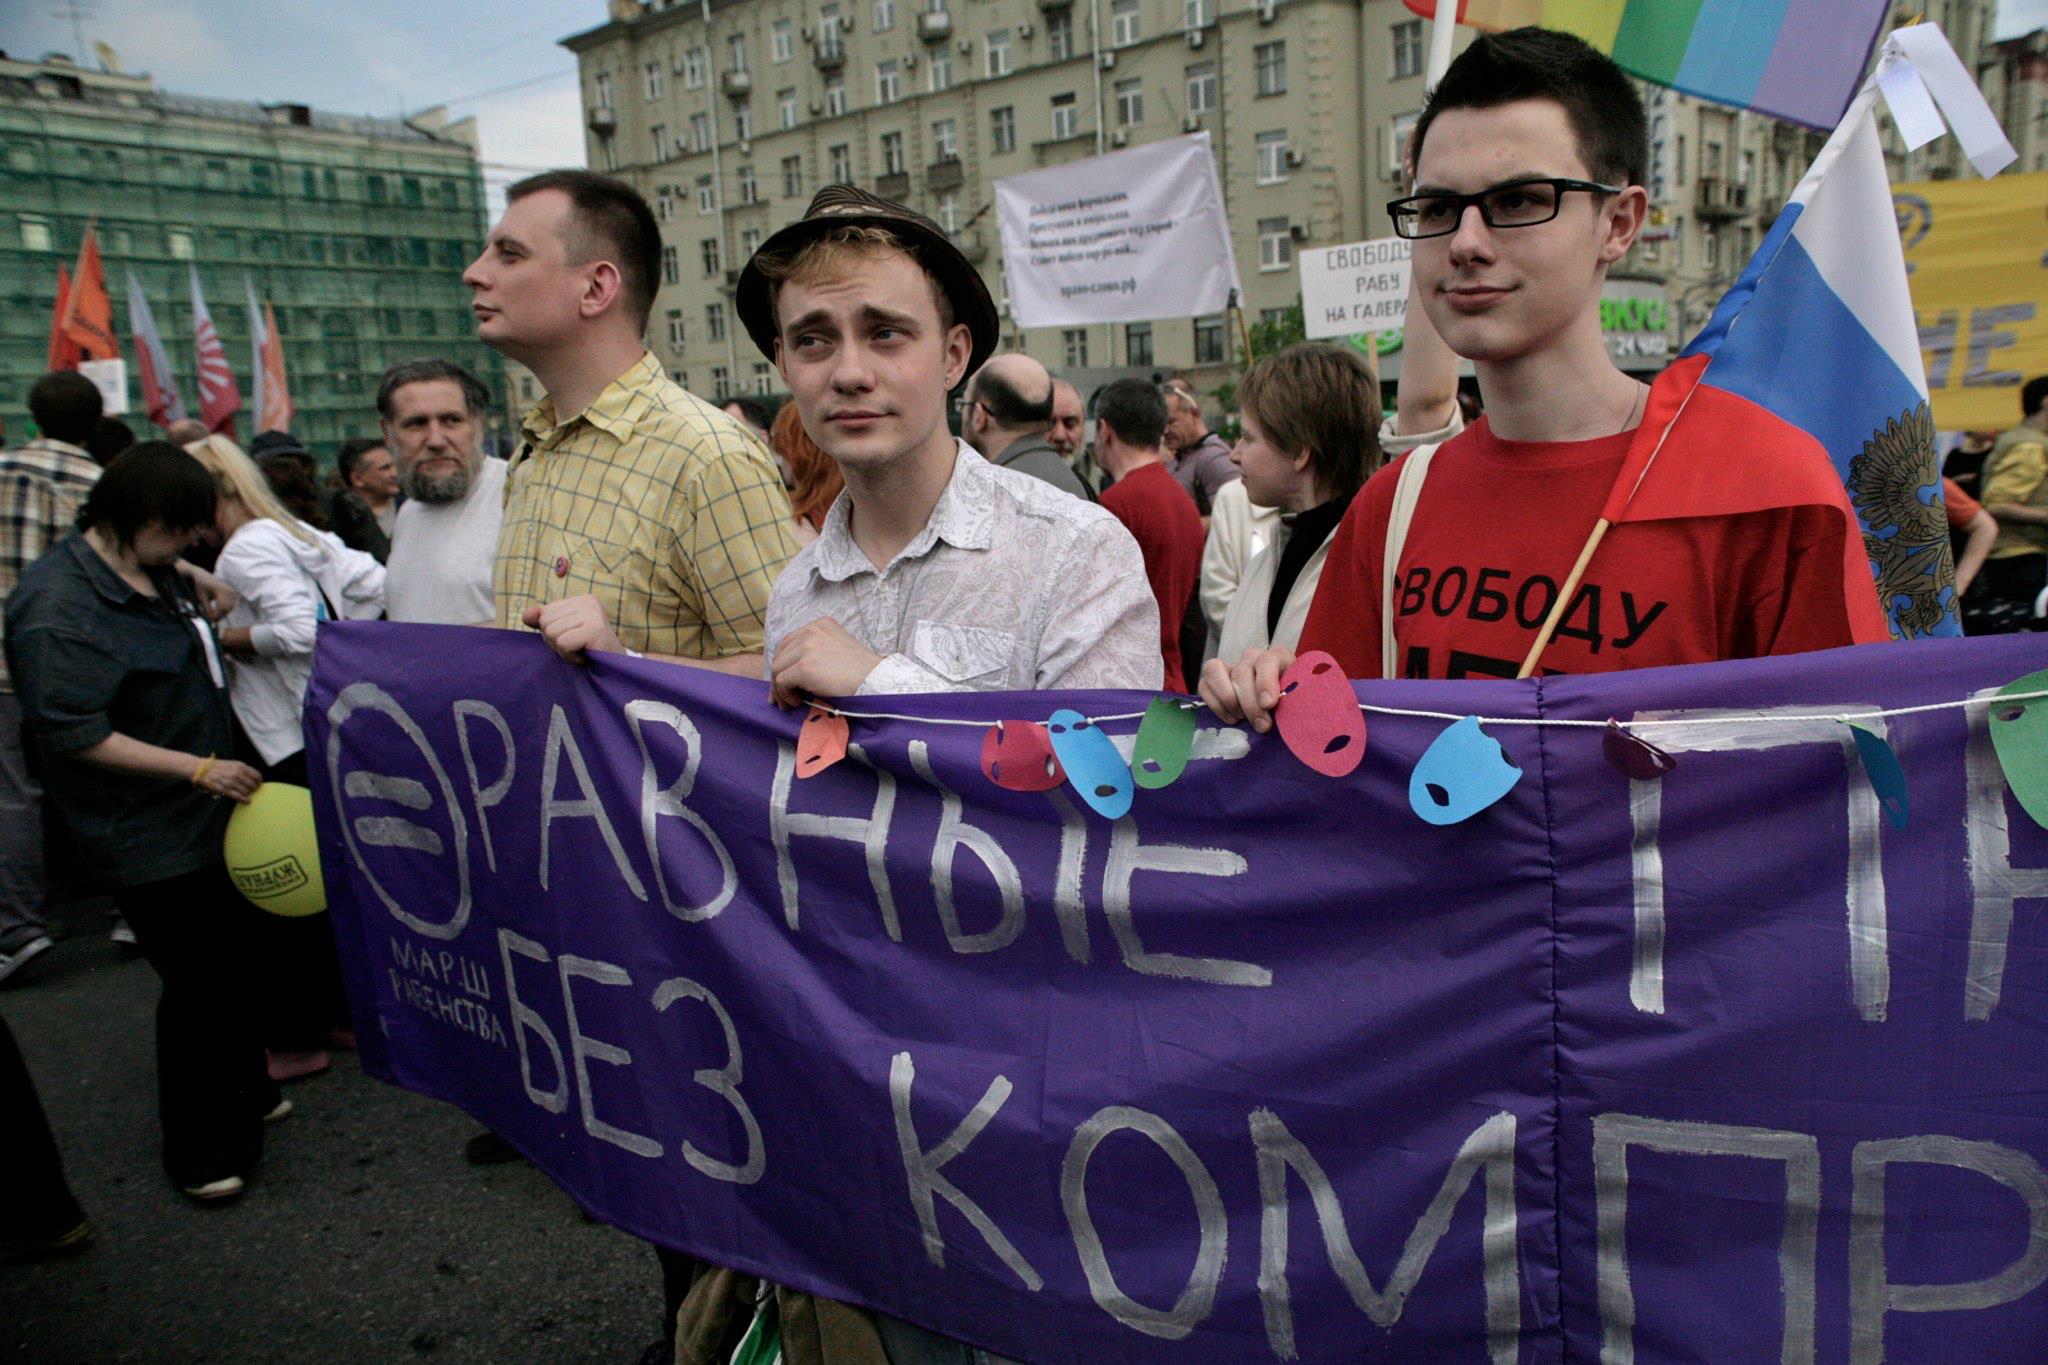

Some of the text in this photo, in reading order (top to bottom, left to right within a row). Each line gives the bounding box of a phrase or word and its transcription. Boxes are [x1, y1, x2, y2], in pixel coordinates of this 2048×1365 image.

[1325, 306, 1347, 322] НА
[1355, 272, 1401, 294] РАБУ
[1394, 565, 1669, 655] ВОБОДУ
[452, 698, 1273, 988] РАВНЫЕ
[390, 937, 491, 1001] МАРШ
[497, 927, 766, 1186] БЕЗ
